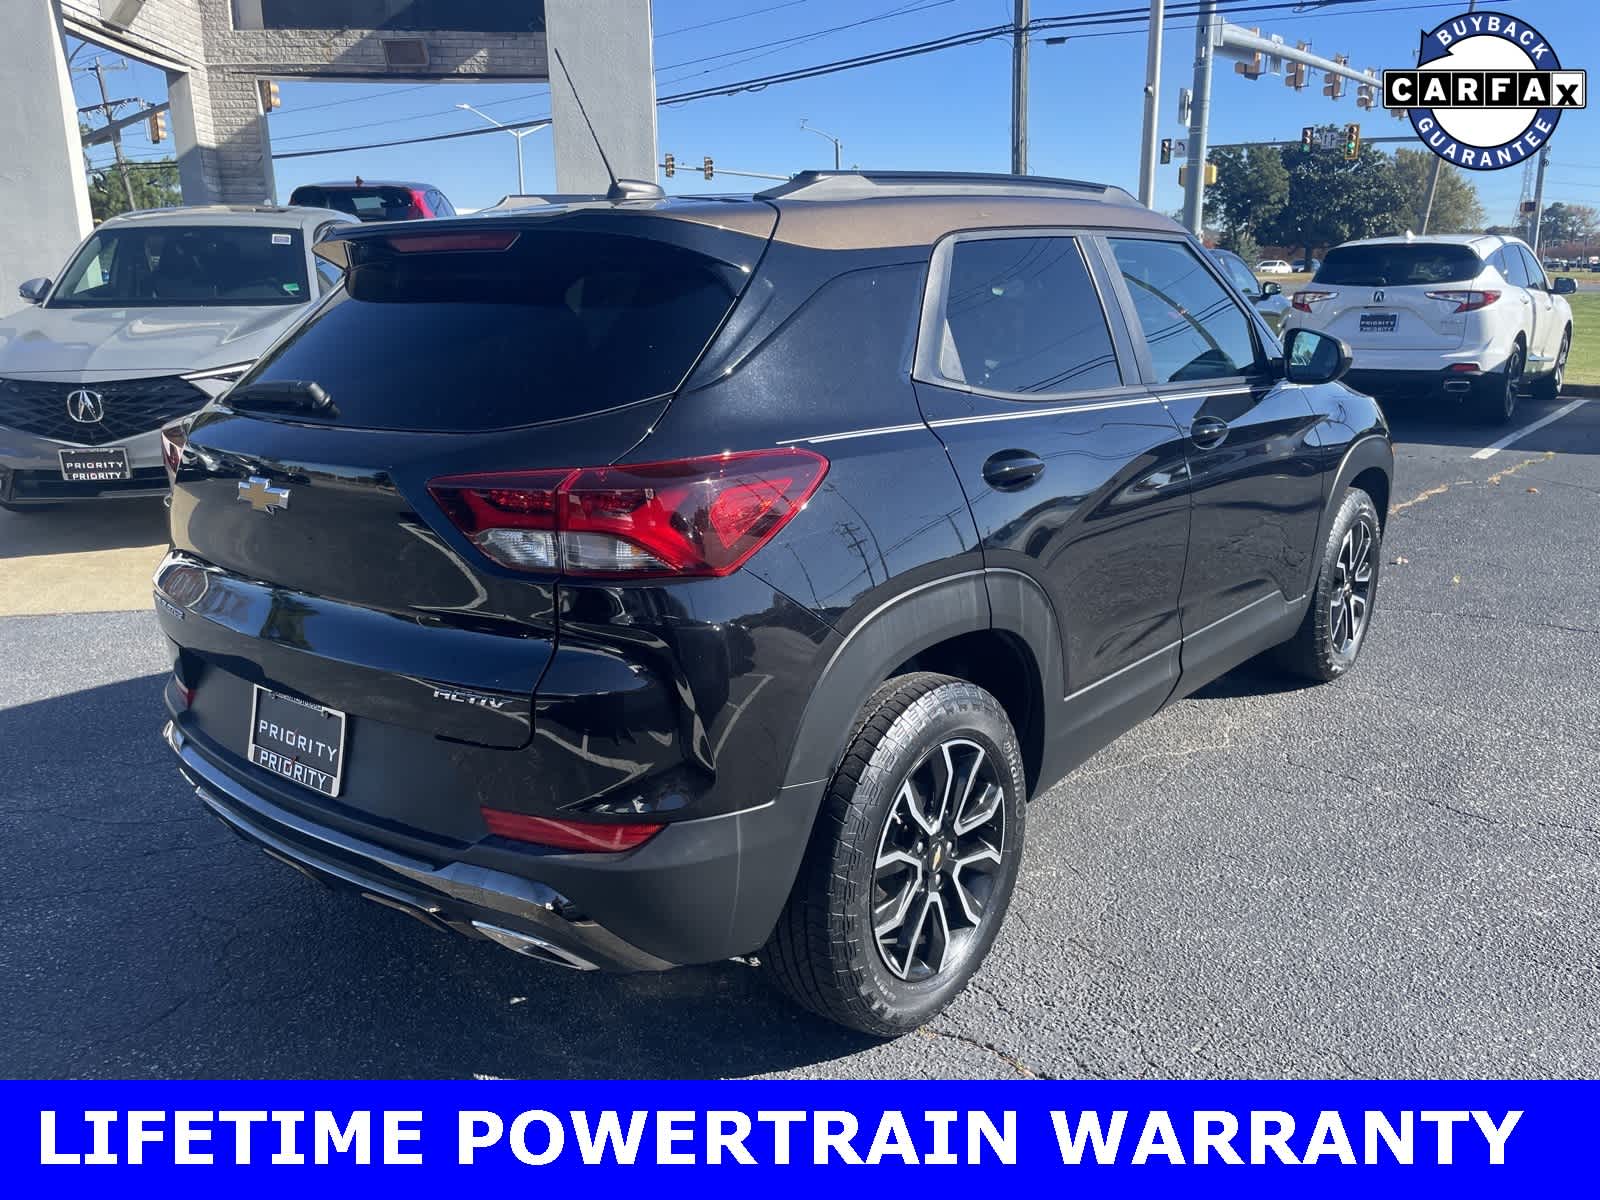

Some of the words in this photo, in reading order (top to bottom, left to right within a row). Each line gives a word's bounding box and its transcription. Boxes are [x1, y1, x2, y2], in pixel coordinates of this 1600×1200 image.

[66, 461, 123, 470] PRIORITY
[72, 471, 122, 480] PRIORITY
[259, 719, 338, 762] PRIORITY
[259, 750, 327, 789] PRIORITY
